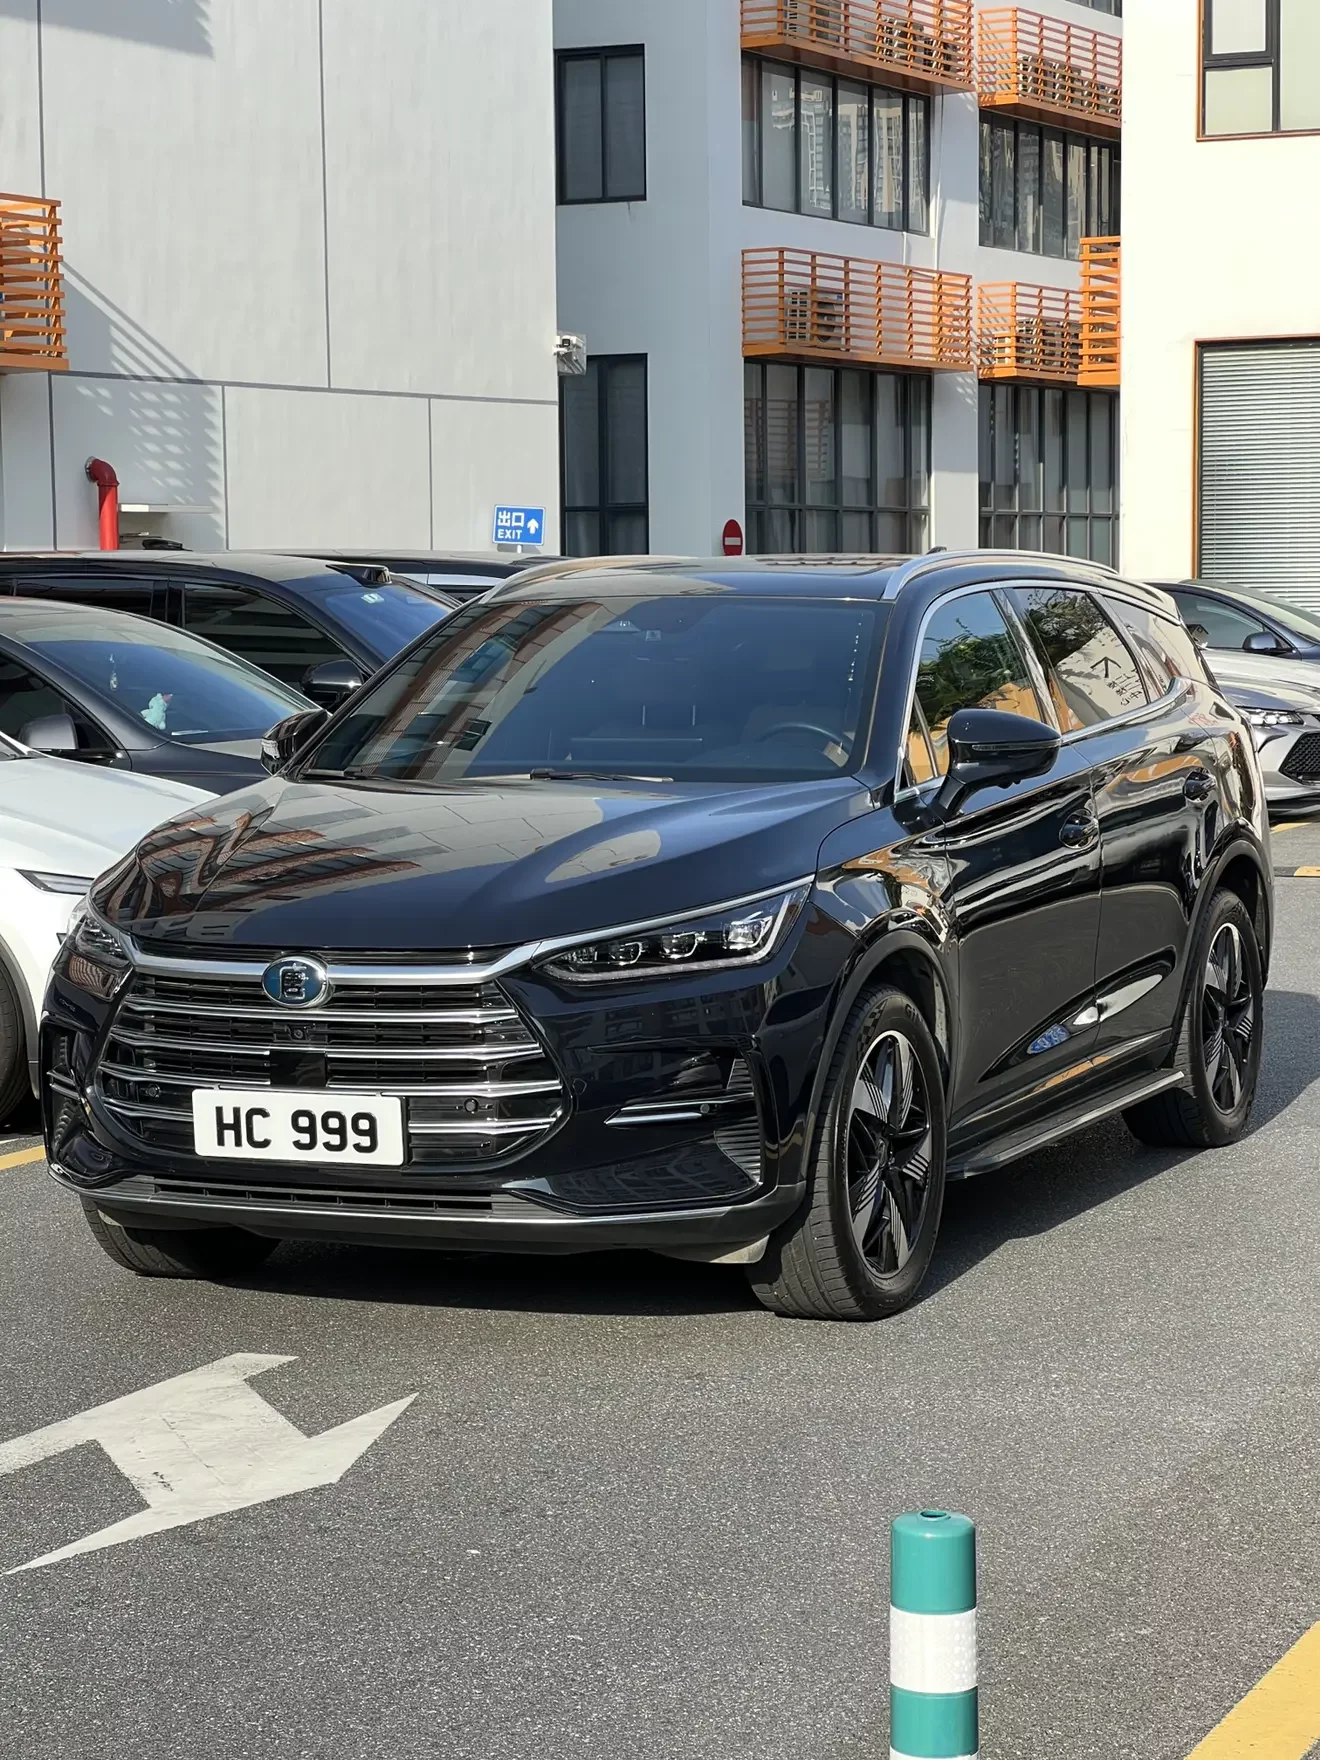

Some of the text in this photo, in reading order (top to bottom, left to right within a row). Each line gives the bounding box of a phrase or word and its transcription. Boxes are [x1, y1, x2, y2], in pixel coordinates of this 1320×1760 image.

[497, 510, 525, 527] 出口
[497, 528, 523, 540] EXIT
[215, 1106, 378, 1154] HC 999
